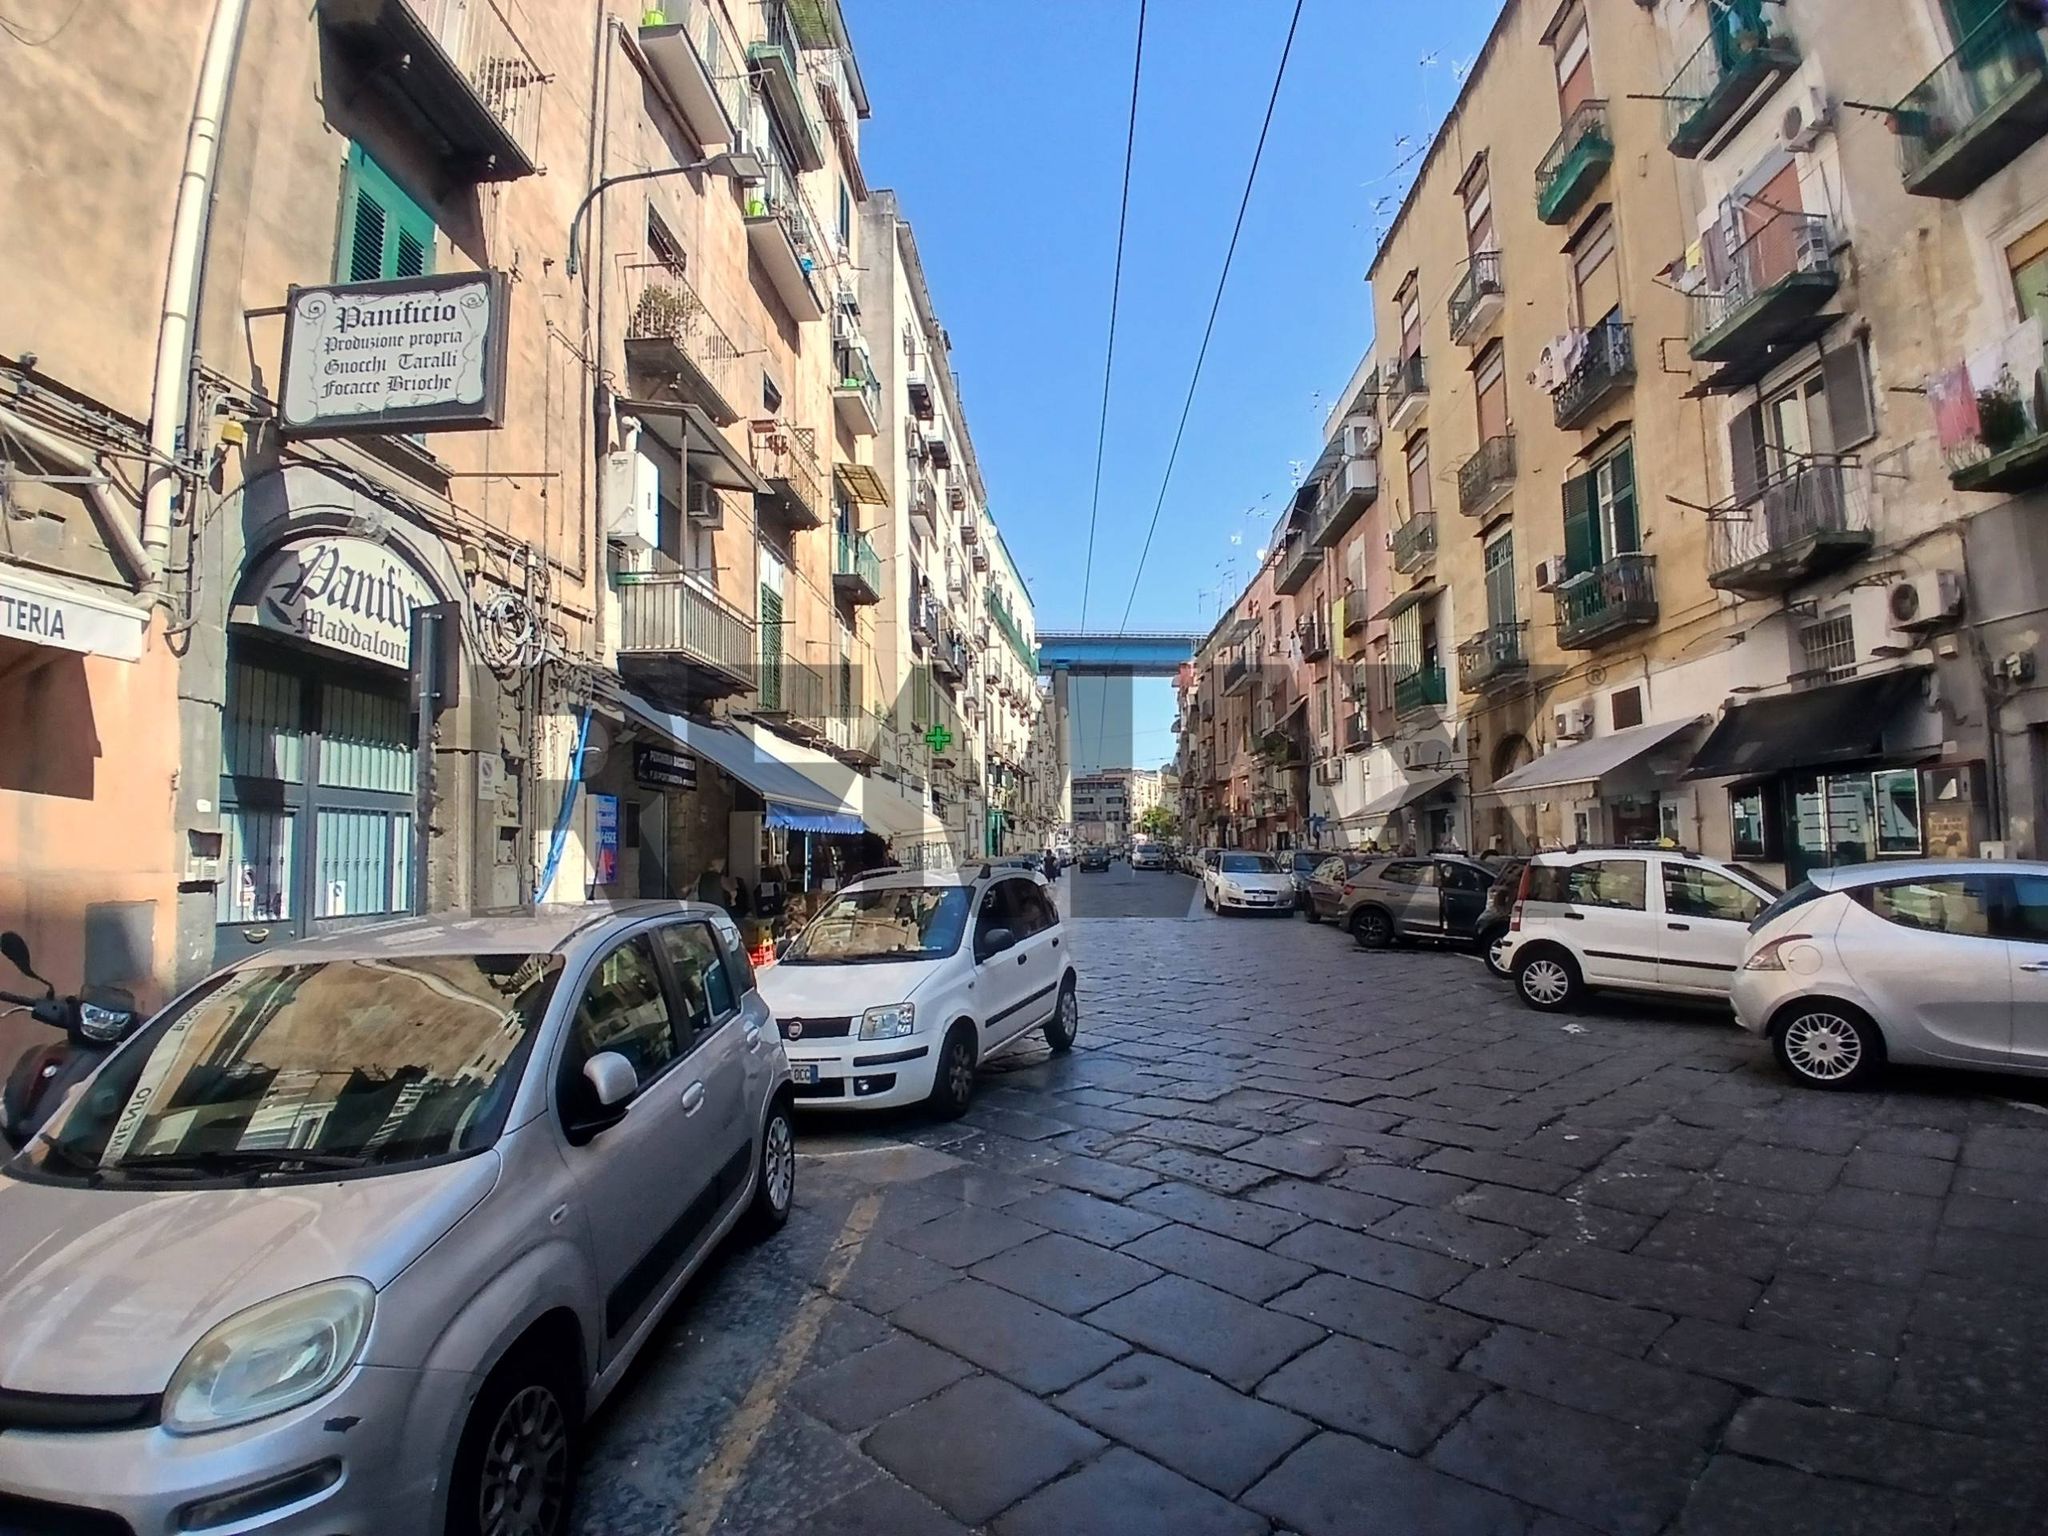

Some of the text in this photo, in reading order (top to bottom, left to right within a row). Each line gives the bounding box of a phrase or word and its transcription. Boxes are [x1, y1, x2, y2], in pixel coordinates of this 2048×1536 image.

[335, 300, 457, 333] Panificio
[324, 327, 463, 354] Produzione propria
[323, 350, 458, 376] Gnocchi Taralli
[320, 374, 453, 399] Focacce Brioche
[0, 595, 66, 640] TERIA
[295, 607, 407, 663] Maddaloni
